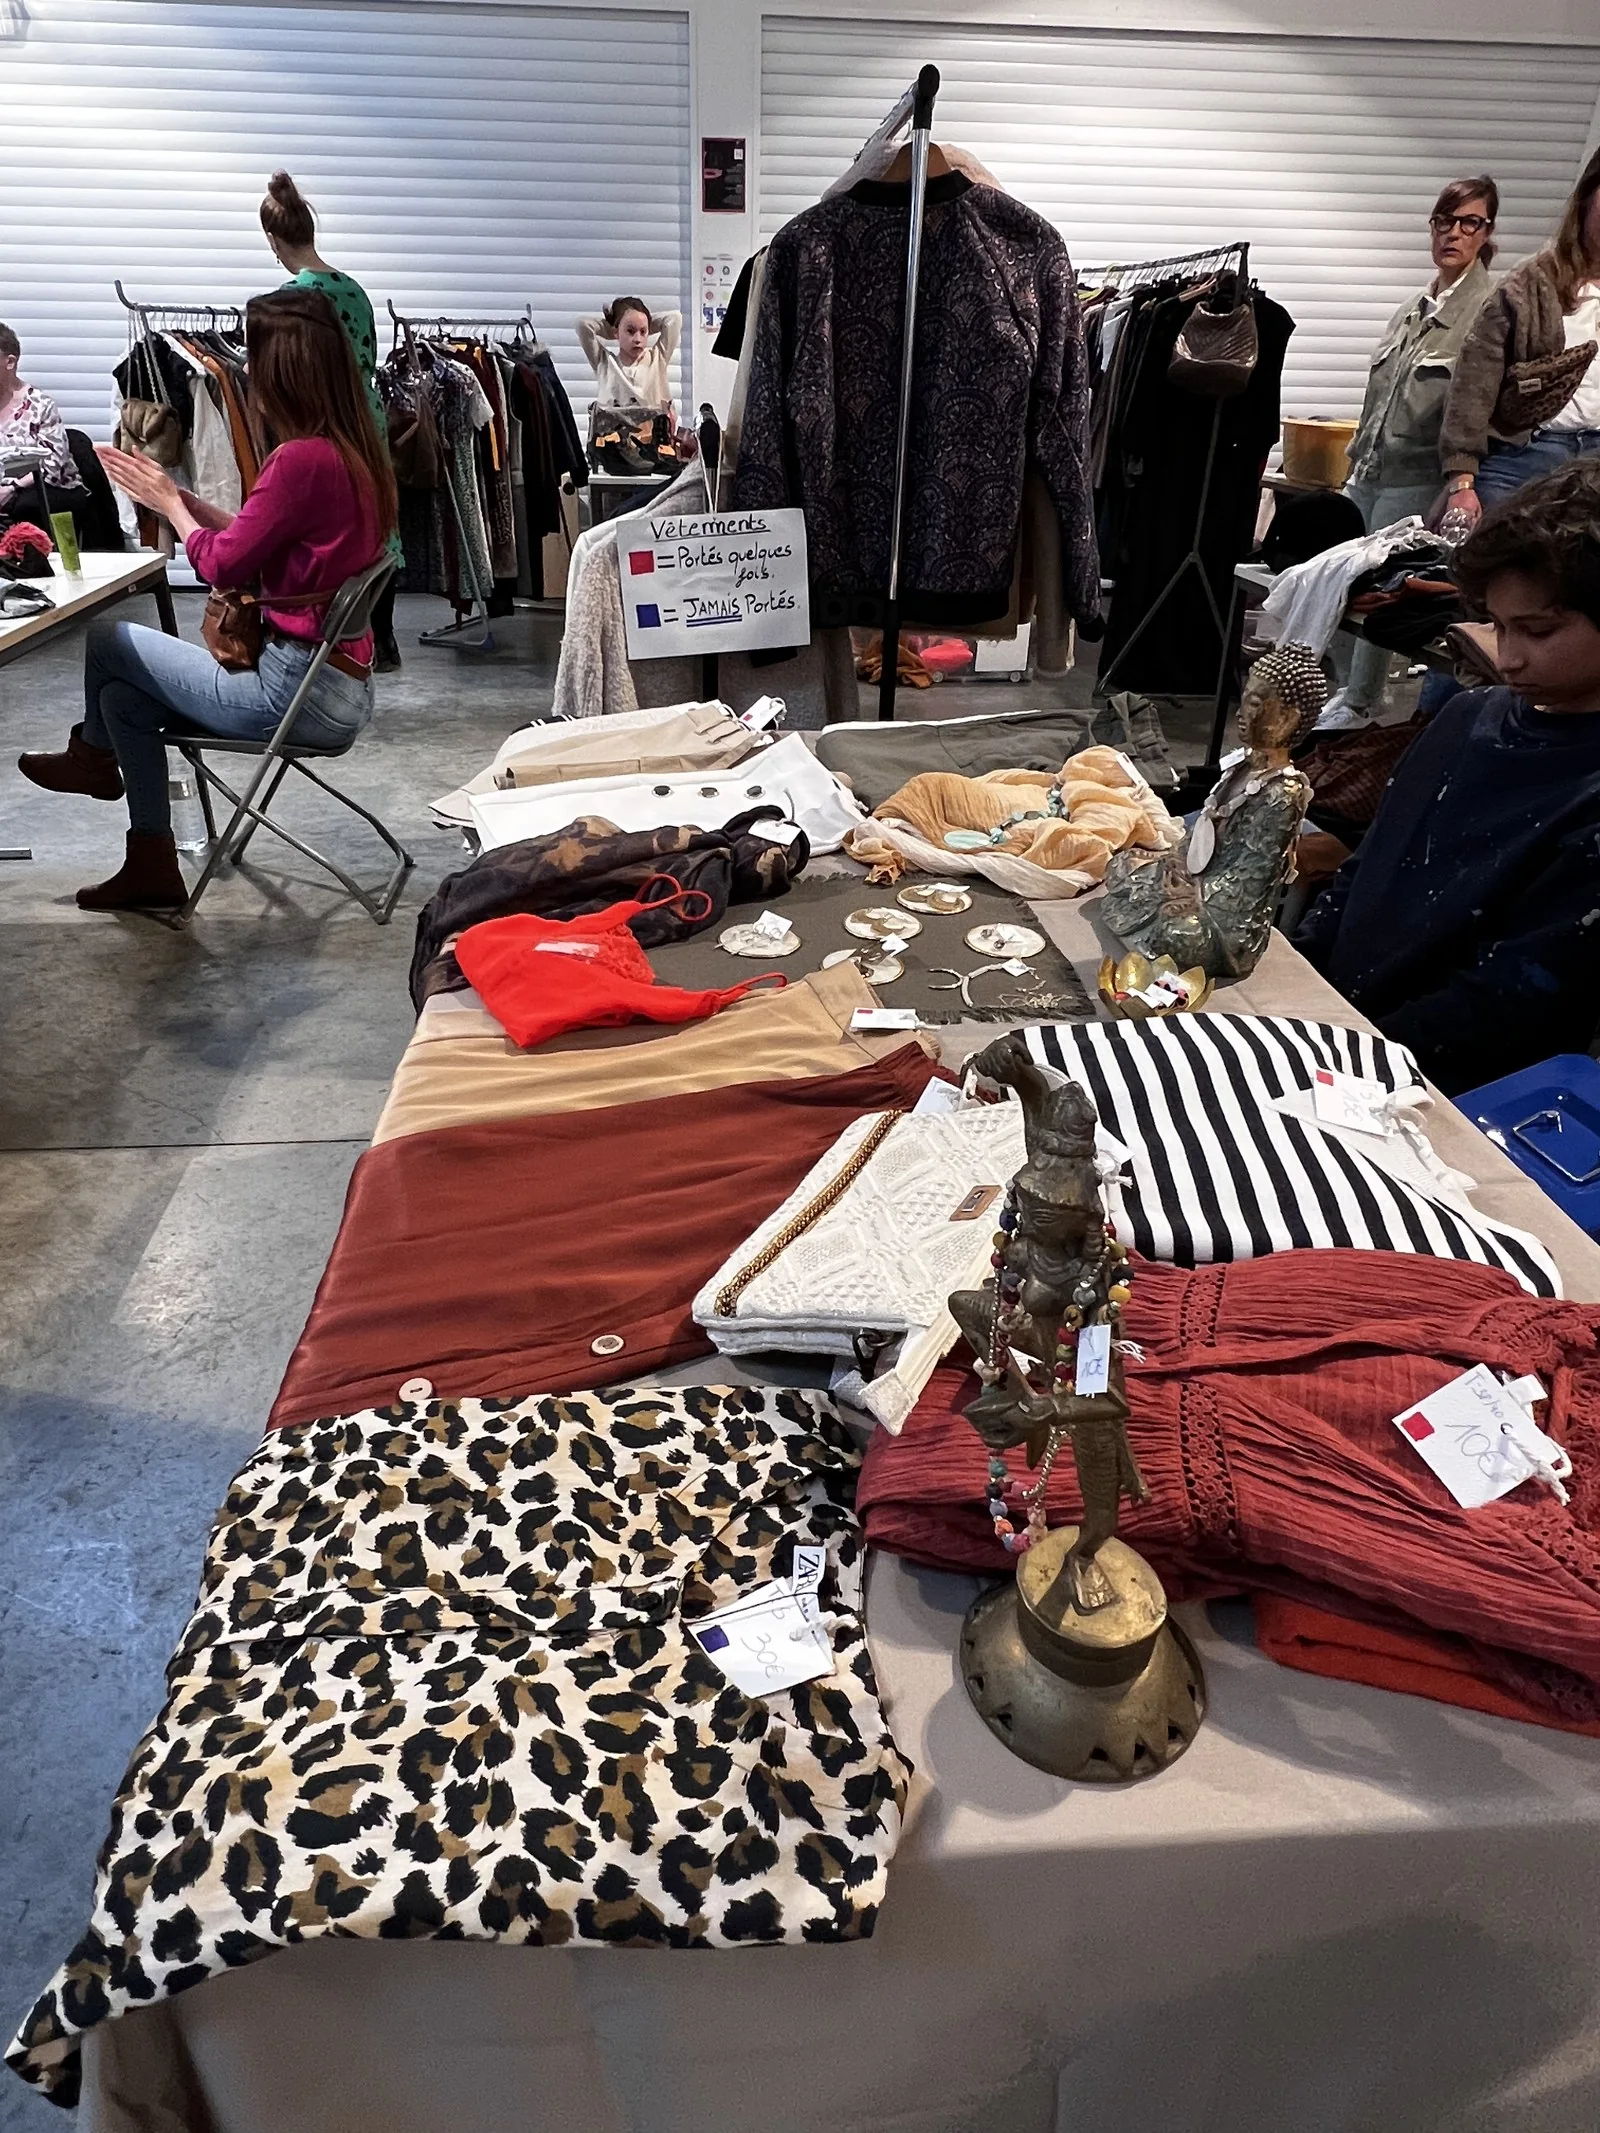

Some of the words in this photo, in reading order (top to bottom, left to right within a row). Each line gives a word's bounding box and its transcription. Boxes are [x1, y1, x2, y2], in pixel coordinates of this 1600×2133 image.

[649, 513, 768, 541] Vêtements
[677, 545, 724, 569] Portés
[727, 541, 793, 575] quelques
